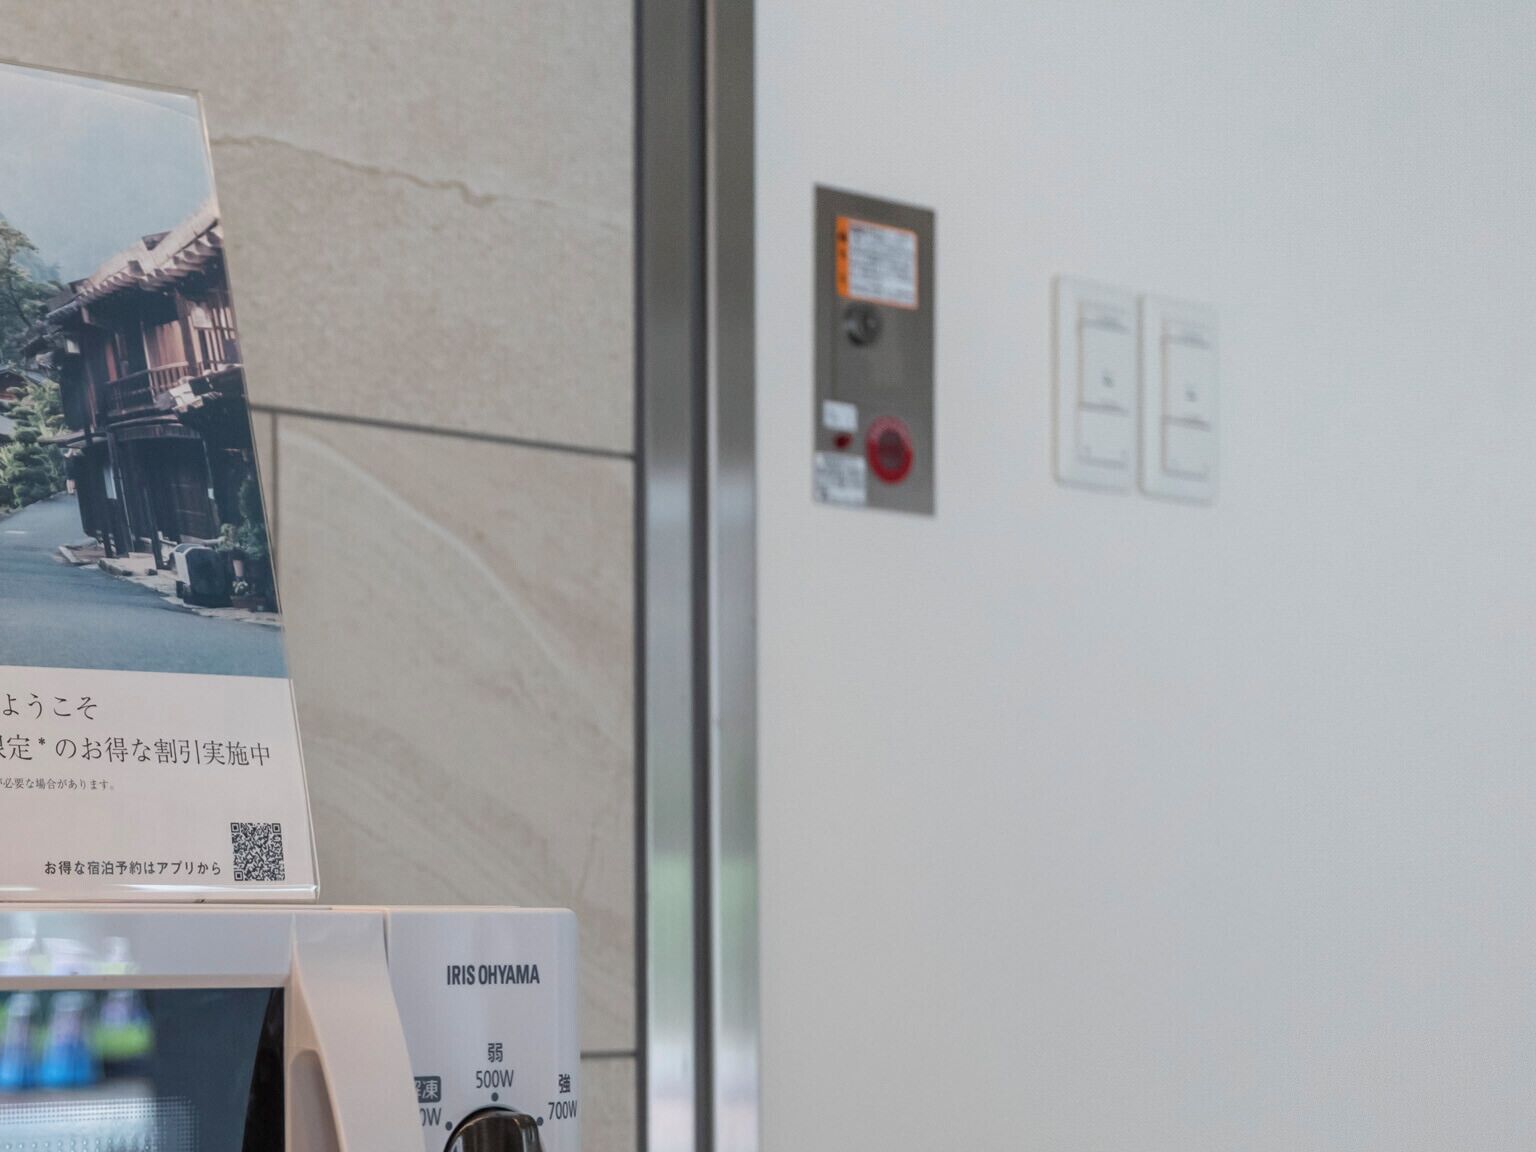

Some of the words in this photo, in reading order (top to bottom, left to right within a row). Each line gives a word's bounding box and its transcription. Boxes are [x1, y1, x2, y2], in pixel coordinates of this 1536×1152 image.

[55, 736, 271, 766] のお得な割引実施中
[44, 860, 222, 876] お得な宿泊予約はアプリから
[446, 964, 476, 986] IRIS
[478, 964, 541, 985] OHYAMA
[487, 1042, 504, 1063] 弱
[475, 1069, 515, 1089] 500W
[558, 1073, 571, 1094] 強
[547, 1100, 578, 1121] 700W
